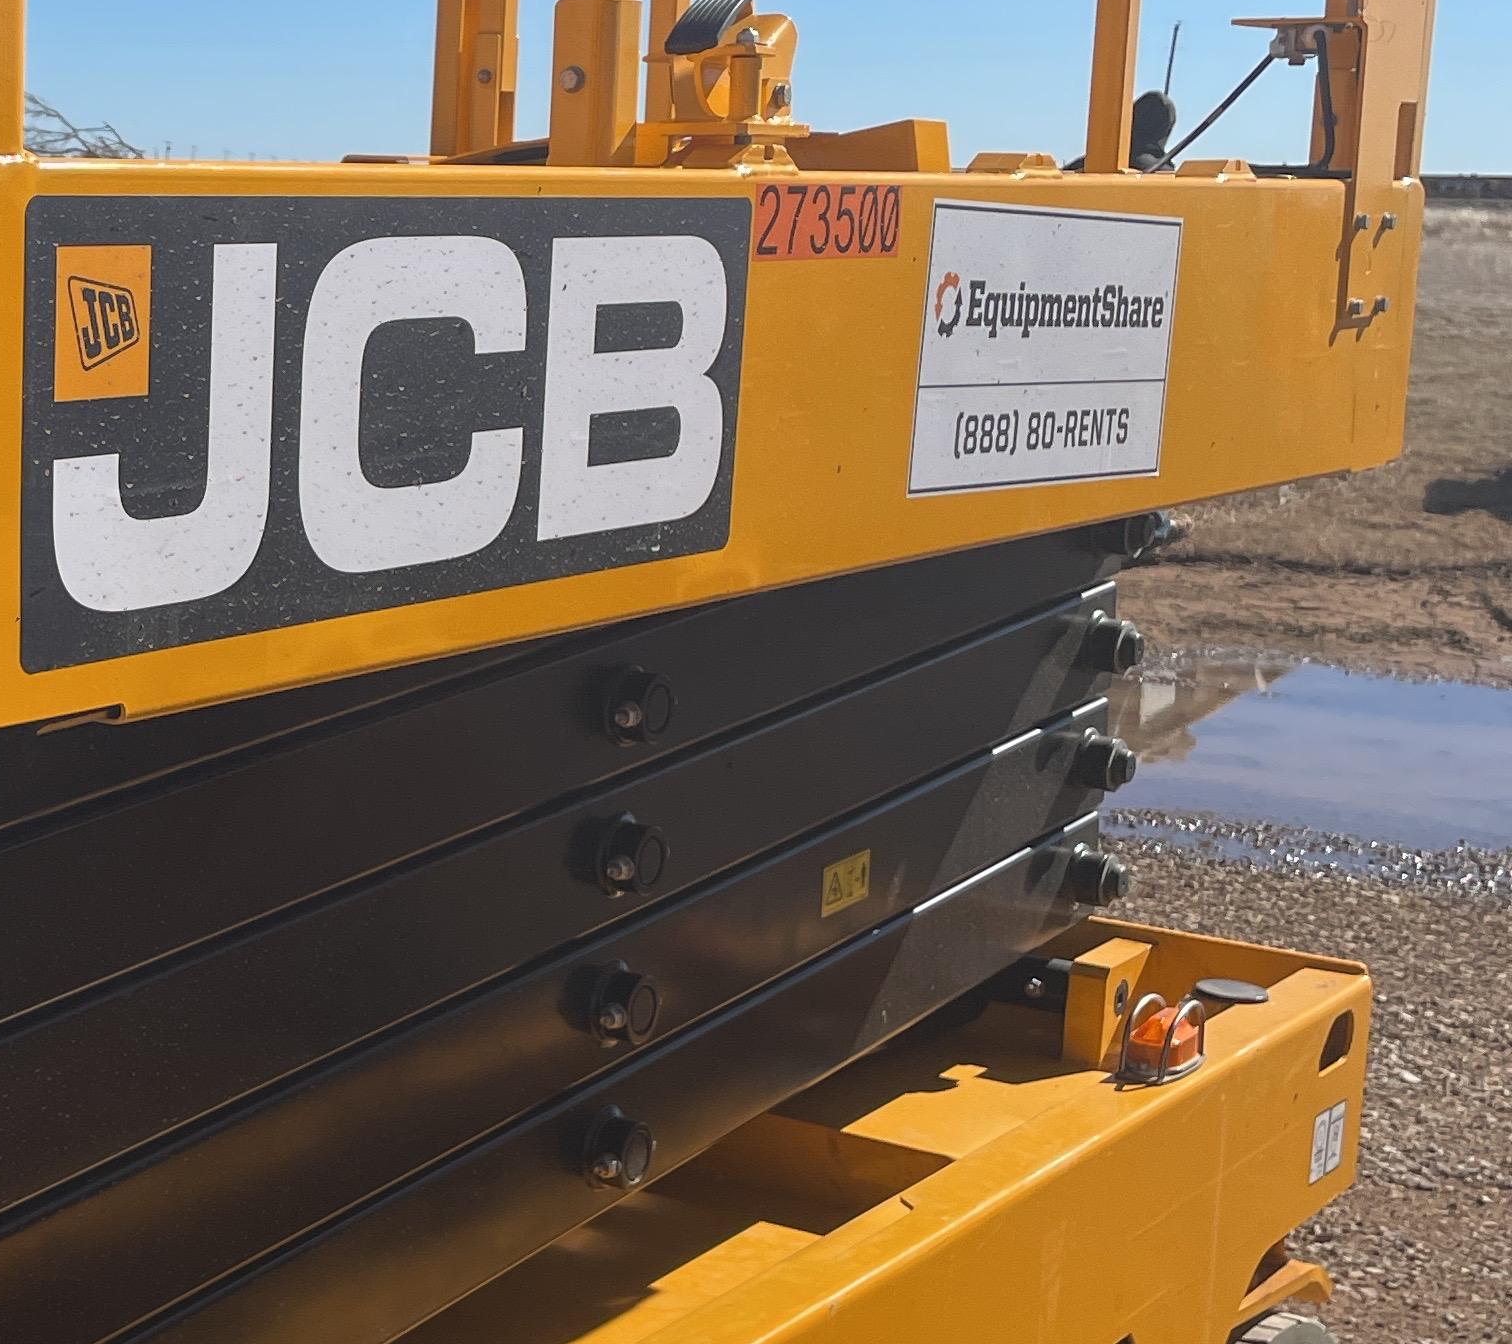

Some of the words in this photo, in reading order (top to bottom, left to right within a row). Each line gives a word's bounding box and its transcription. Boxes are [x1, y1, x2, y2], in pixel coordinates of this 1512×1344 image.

[756, 184, 902, 256] 273500
[80, 287, 140, 359] JCB
[965, 281, 1165, 339] EquipmentShare
[53, 235, 728, 613] JCB
[954, 410, 1020, 459] (888)
[1026, 407, 1130, 451] 80-RENTS
